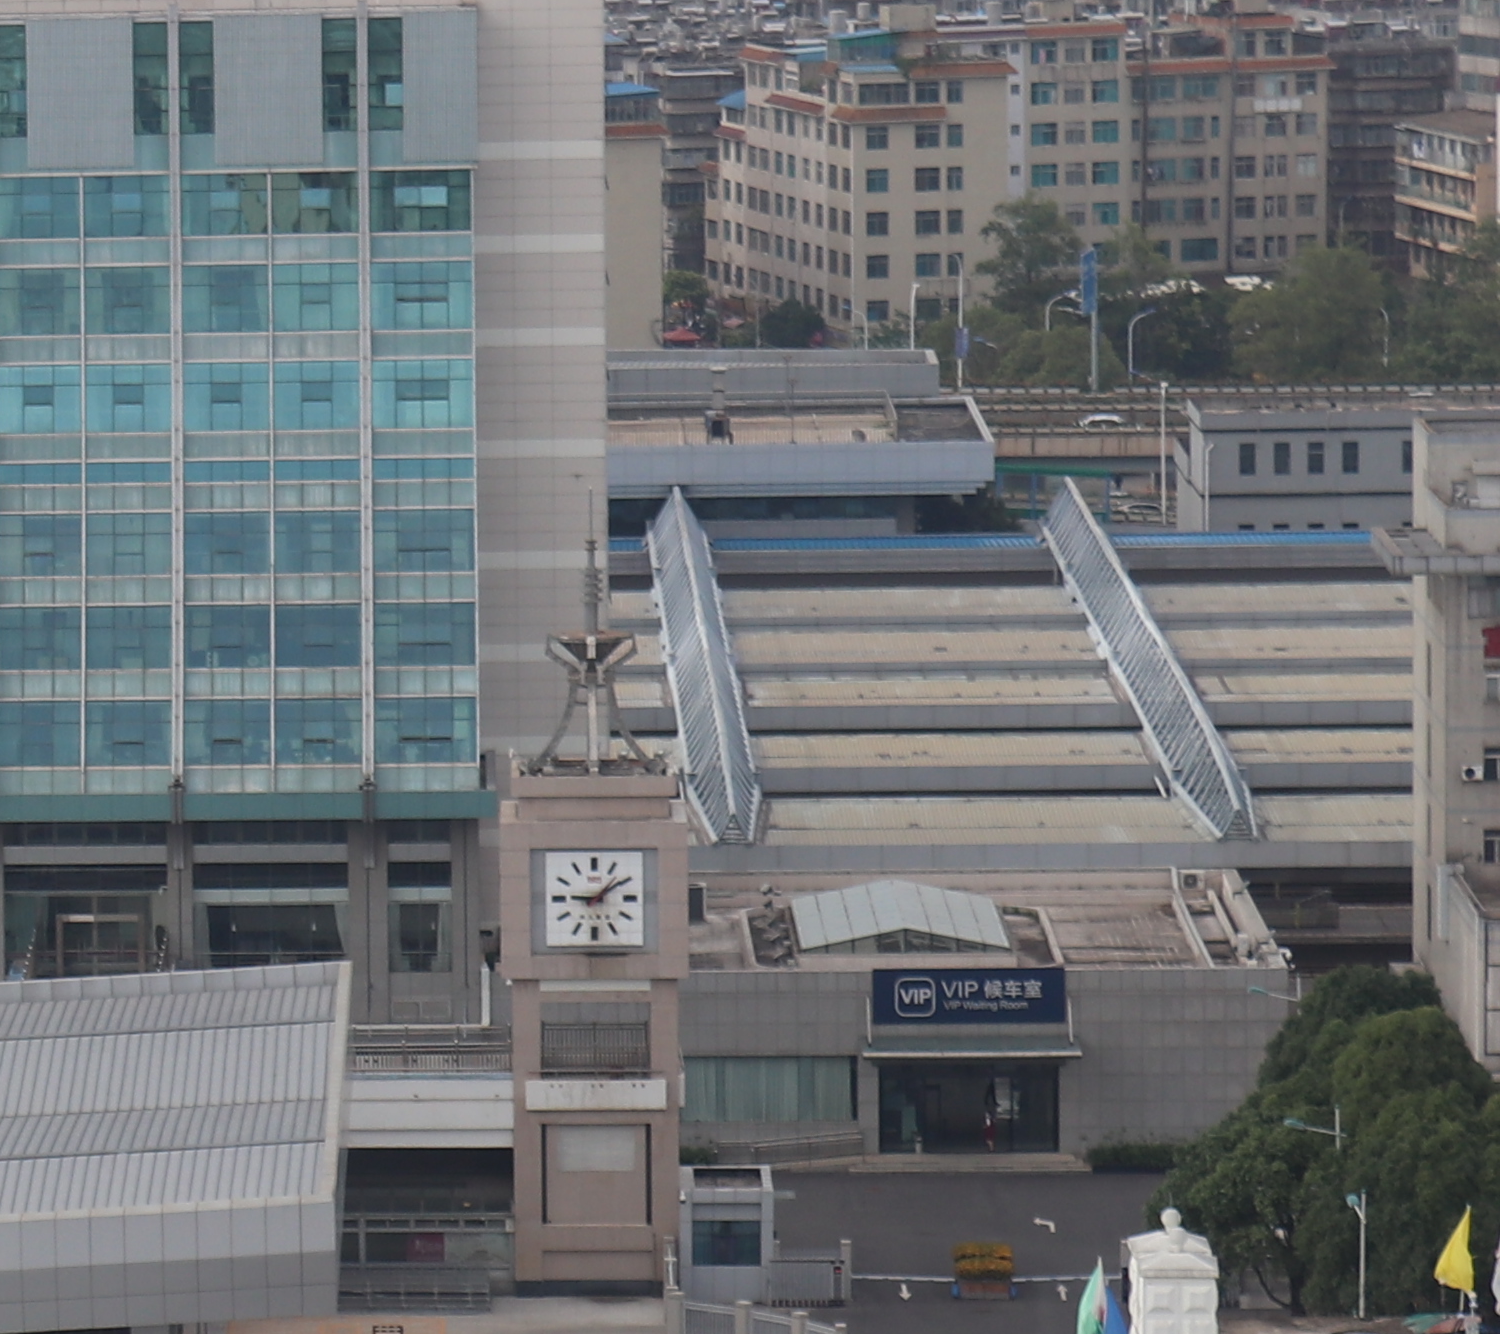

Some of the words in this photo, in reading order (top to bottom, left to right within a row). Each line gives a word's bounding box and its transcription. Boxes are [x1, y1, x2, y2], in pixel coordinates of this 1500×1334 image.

[899, 988, 932, 1005] VIP
[941, 981, 979, 998] VIP
[984, 980, 1043, 999] 候车室
[943, 1001, 962, 1010] VIP
[963, 1001, 998, 1012] Waiting
[1001, 1001, 1029, 1010] Room
